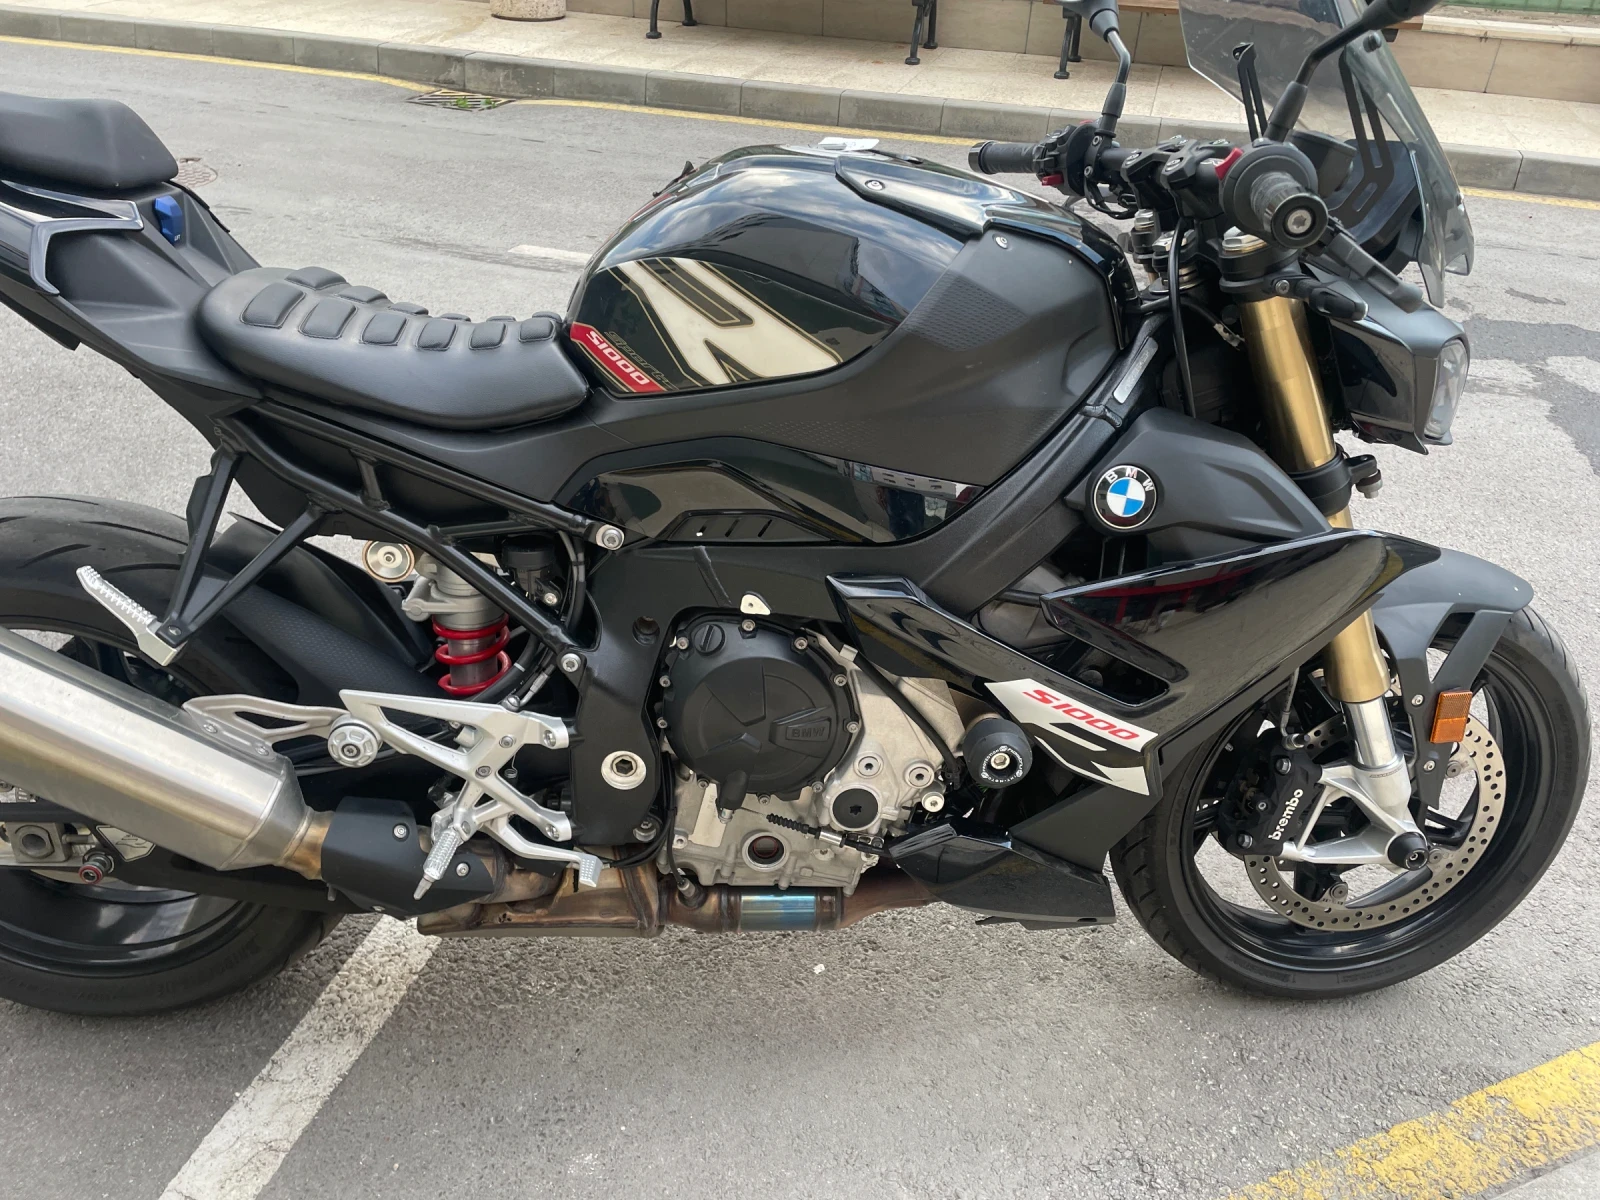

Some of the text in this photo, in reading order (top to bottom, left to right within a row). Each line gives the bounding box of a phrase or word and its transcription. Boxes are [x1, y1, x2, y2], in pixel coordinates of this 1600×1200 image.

[585, 330, 650, 385] S1000
[1104, 466, 1155, 492] BMW
[791, 726, 826, 739] BMW
[1021, 688, 1140, 741] S1000
[1267, 788, 1304, 841] brembo
